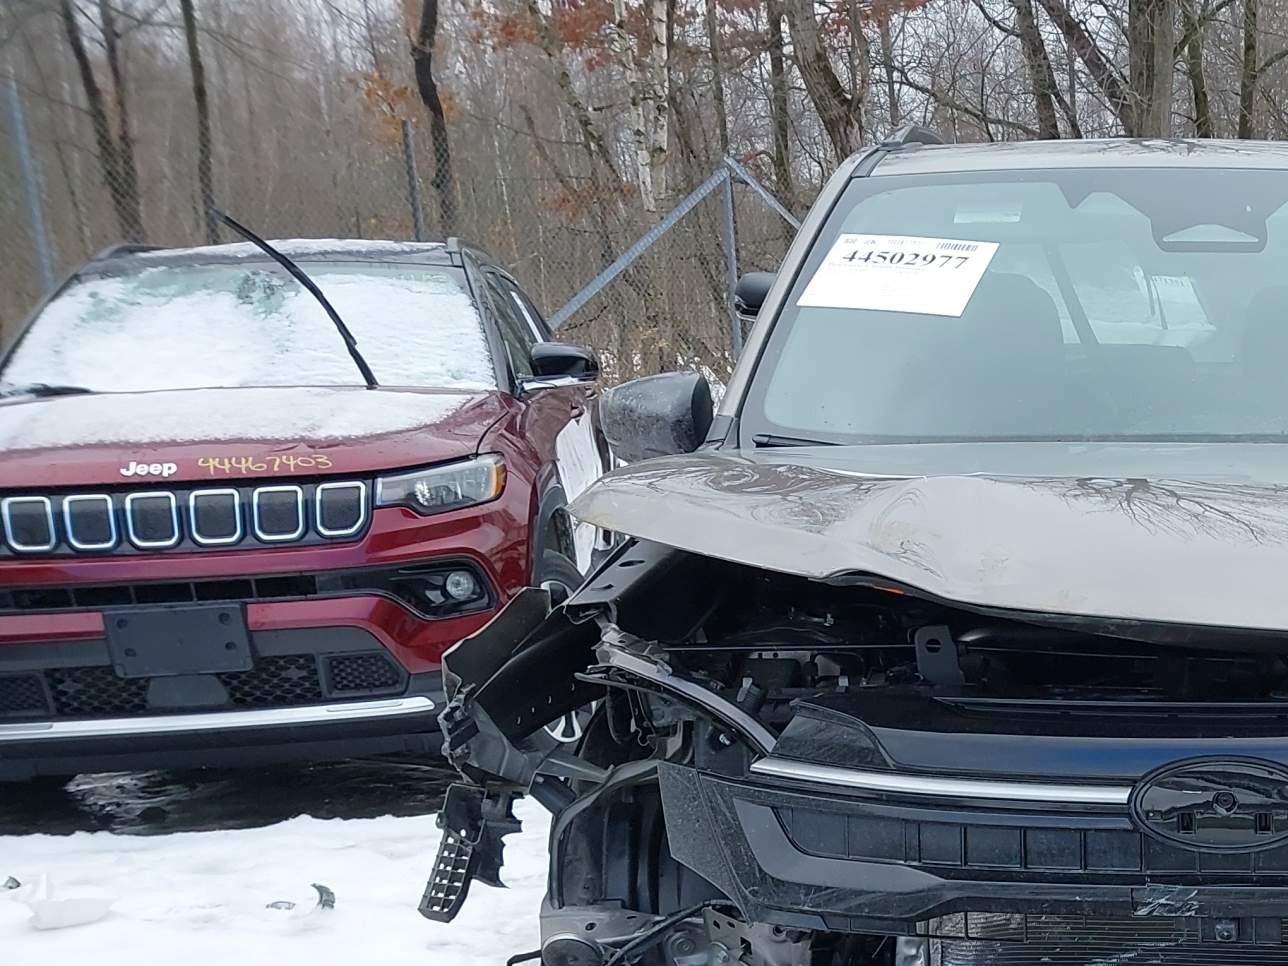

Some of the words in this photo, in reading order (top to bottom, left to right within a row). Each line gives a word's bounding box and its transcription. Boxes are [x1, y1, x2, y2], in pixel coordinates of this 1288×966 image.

[842, 250, 970, 270] 44502977
[120, 461, 178, 477] Jeep
[198, 454, 333, 475] 44467403
